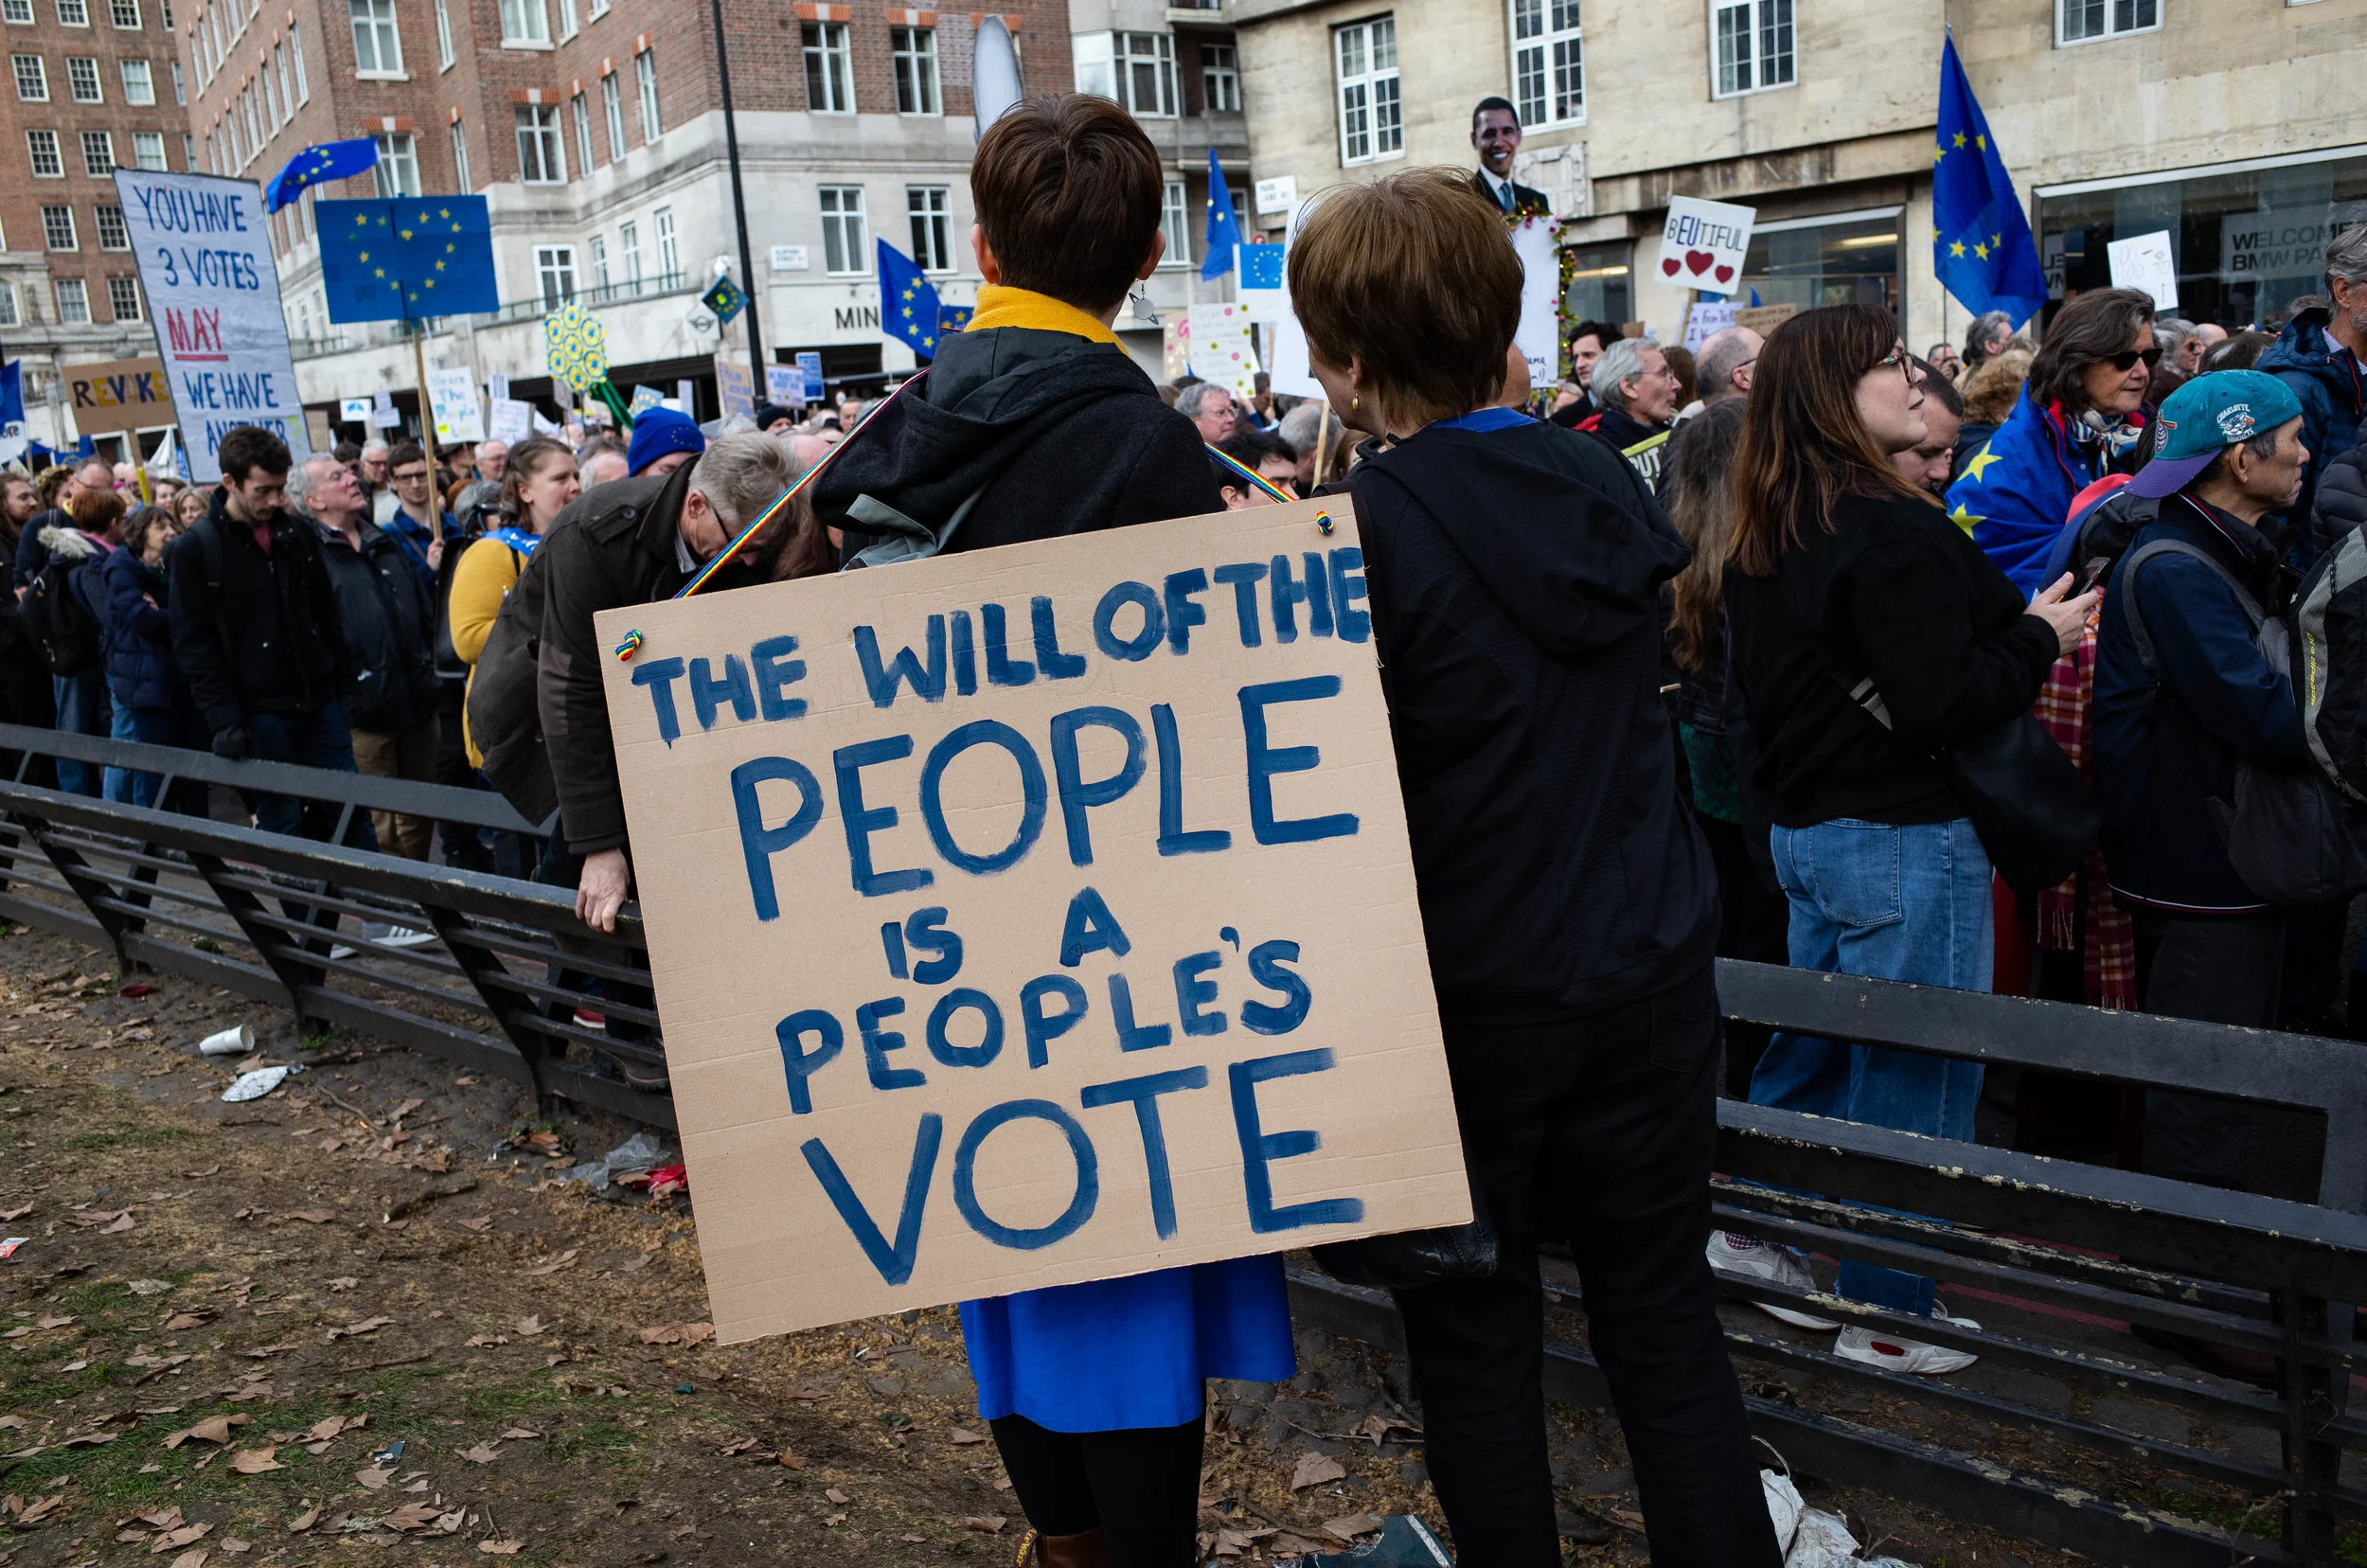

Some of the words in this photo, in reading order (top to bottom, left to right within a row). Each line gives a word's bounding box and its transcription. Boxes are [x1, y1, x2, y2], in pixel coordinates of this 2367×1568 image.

[133, 185, 189, 233] YOU
[189, 191, 247, 233] HAVE
[1667, 216, 1744, 252] BEUTIFUL
[158, 247, 179, 286] 3
[181, 246, 259, 291] VOTES
[2233, 250, 2288, 272] BMW
[166, 307, 222, 351] MAY
[835, 306, 880, 330] MIN
[72, 370, 169, 408] REVKE
[184, 372, 221, 409] WE
[220, 372, 279, 410] HAVE
[632, 635, 808, 749] THE
[854, 597, 1087, 707] WILL
[1093, 568, 1208, 662] OF
[1213, 546, 1371, 648] THE
[731, 675, 1360, 922] PEOPLE
[881, 907, 963, 986] IS
[1059, 886, 1131, 968] A
[775, 926, 1312, 1114] PEOPLE'S
[800, 1048, 1365, 1286] VOTE
